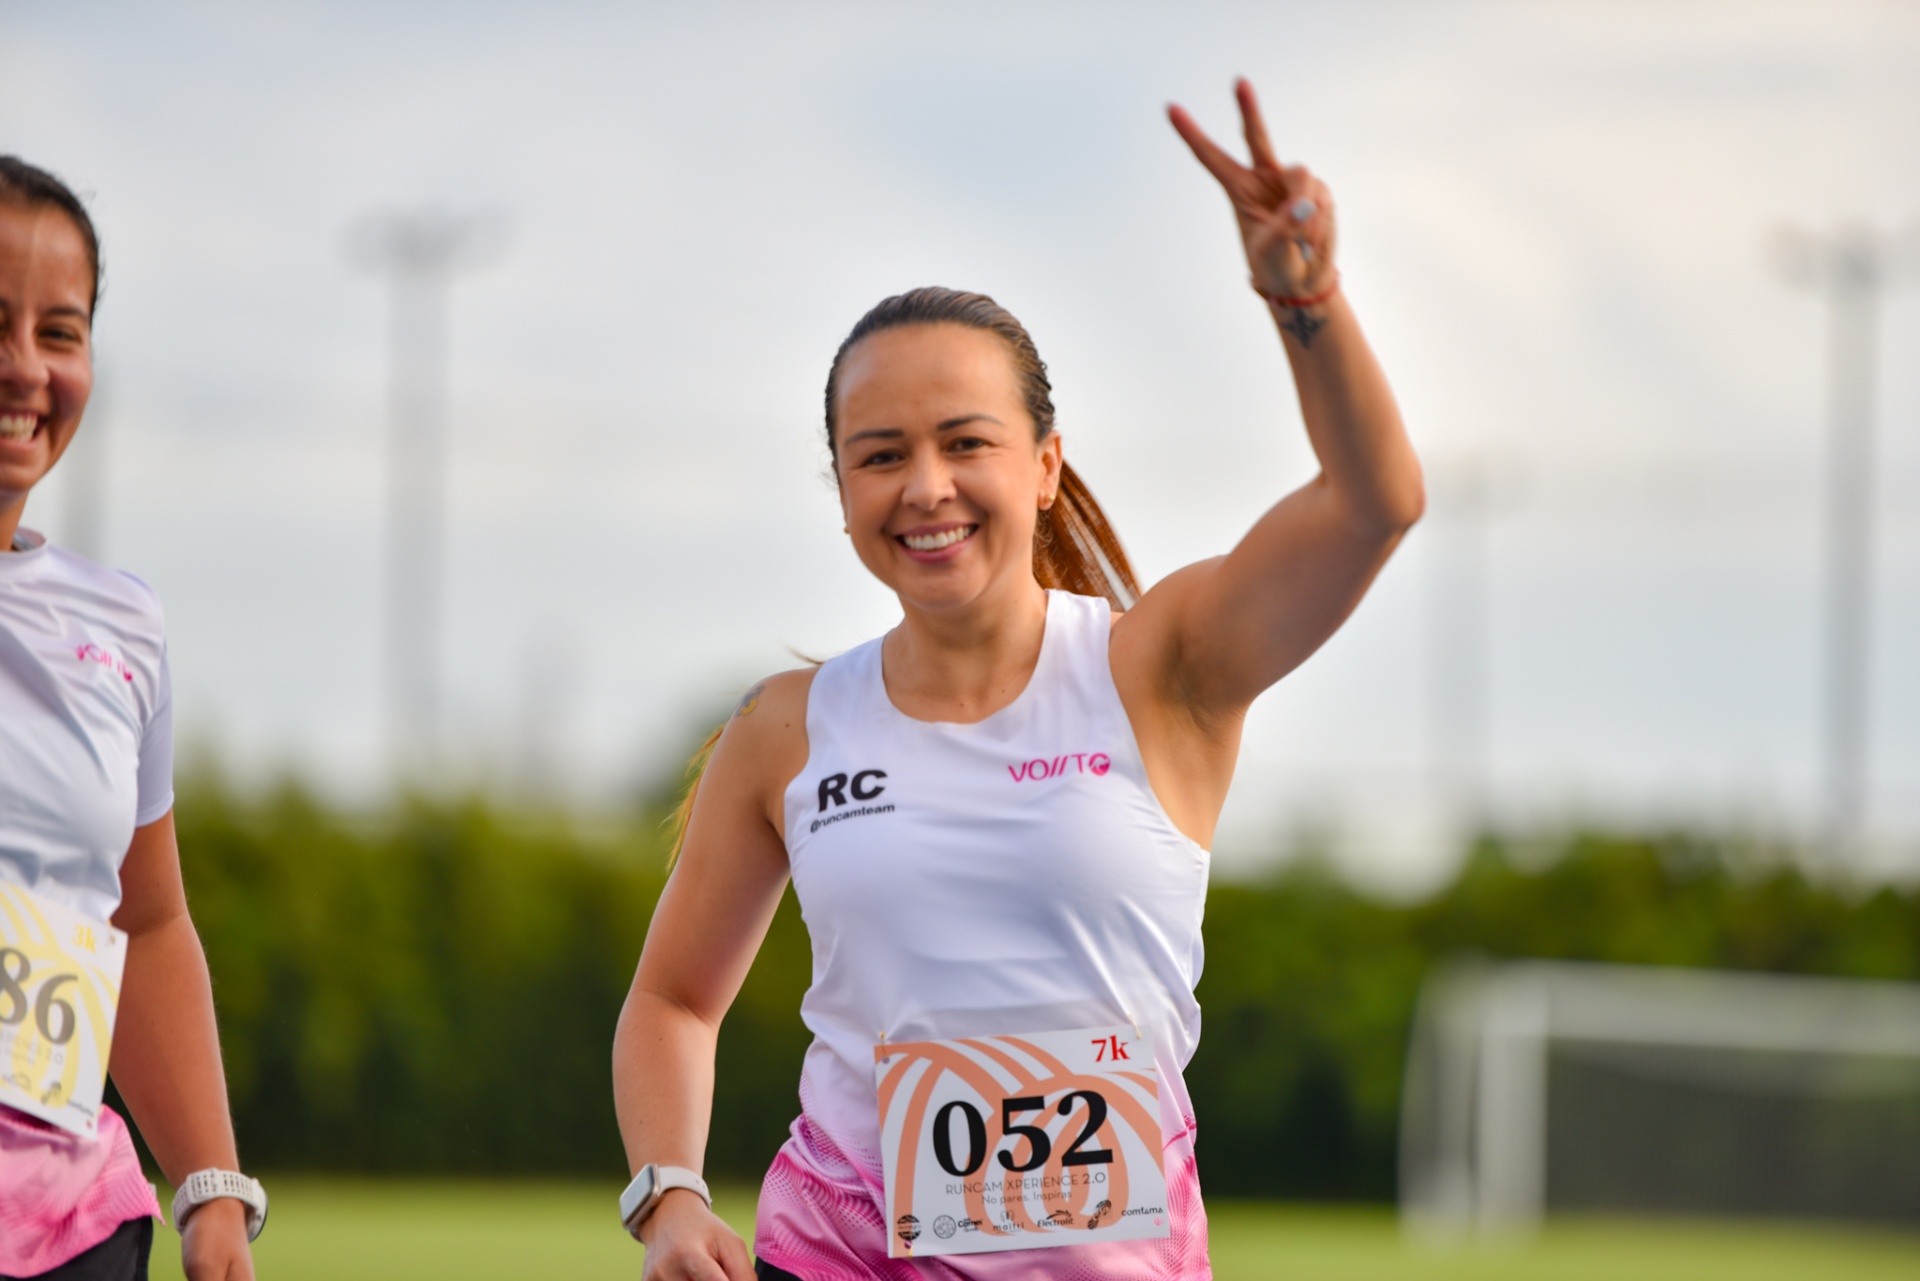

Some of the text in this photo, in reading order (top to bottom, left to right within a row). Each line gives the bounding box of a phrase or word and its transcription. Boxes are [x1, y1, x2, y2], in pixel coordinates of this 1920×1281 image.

[818, 769, 888, 813] RC
[810, 804, 895, 833] @runcamteam
[1091, 1035, 1130, 1062] 7k
[933, 1090, 1113, 1176] 052
[946, 1181, 1003, 1195] RUNCAM
[1007, 1174, 1079, 1191] XPERIENCE
[982, 1195, 997, 1204] No
[1033, 1190, 1072, 1202] Inspiras
[1037, 1218, 1074, 1227] Electrolit
[1121, 1206, 1164, 1216] comfama
